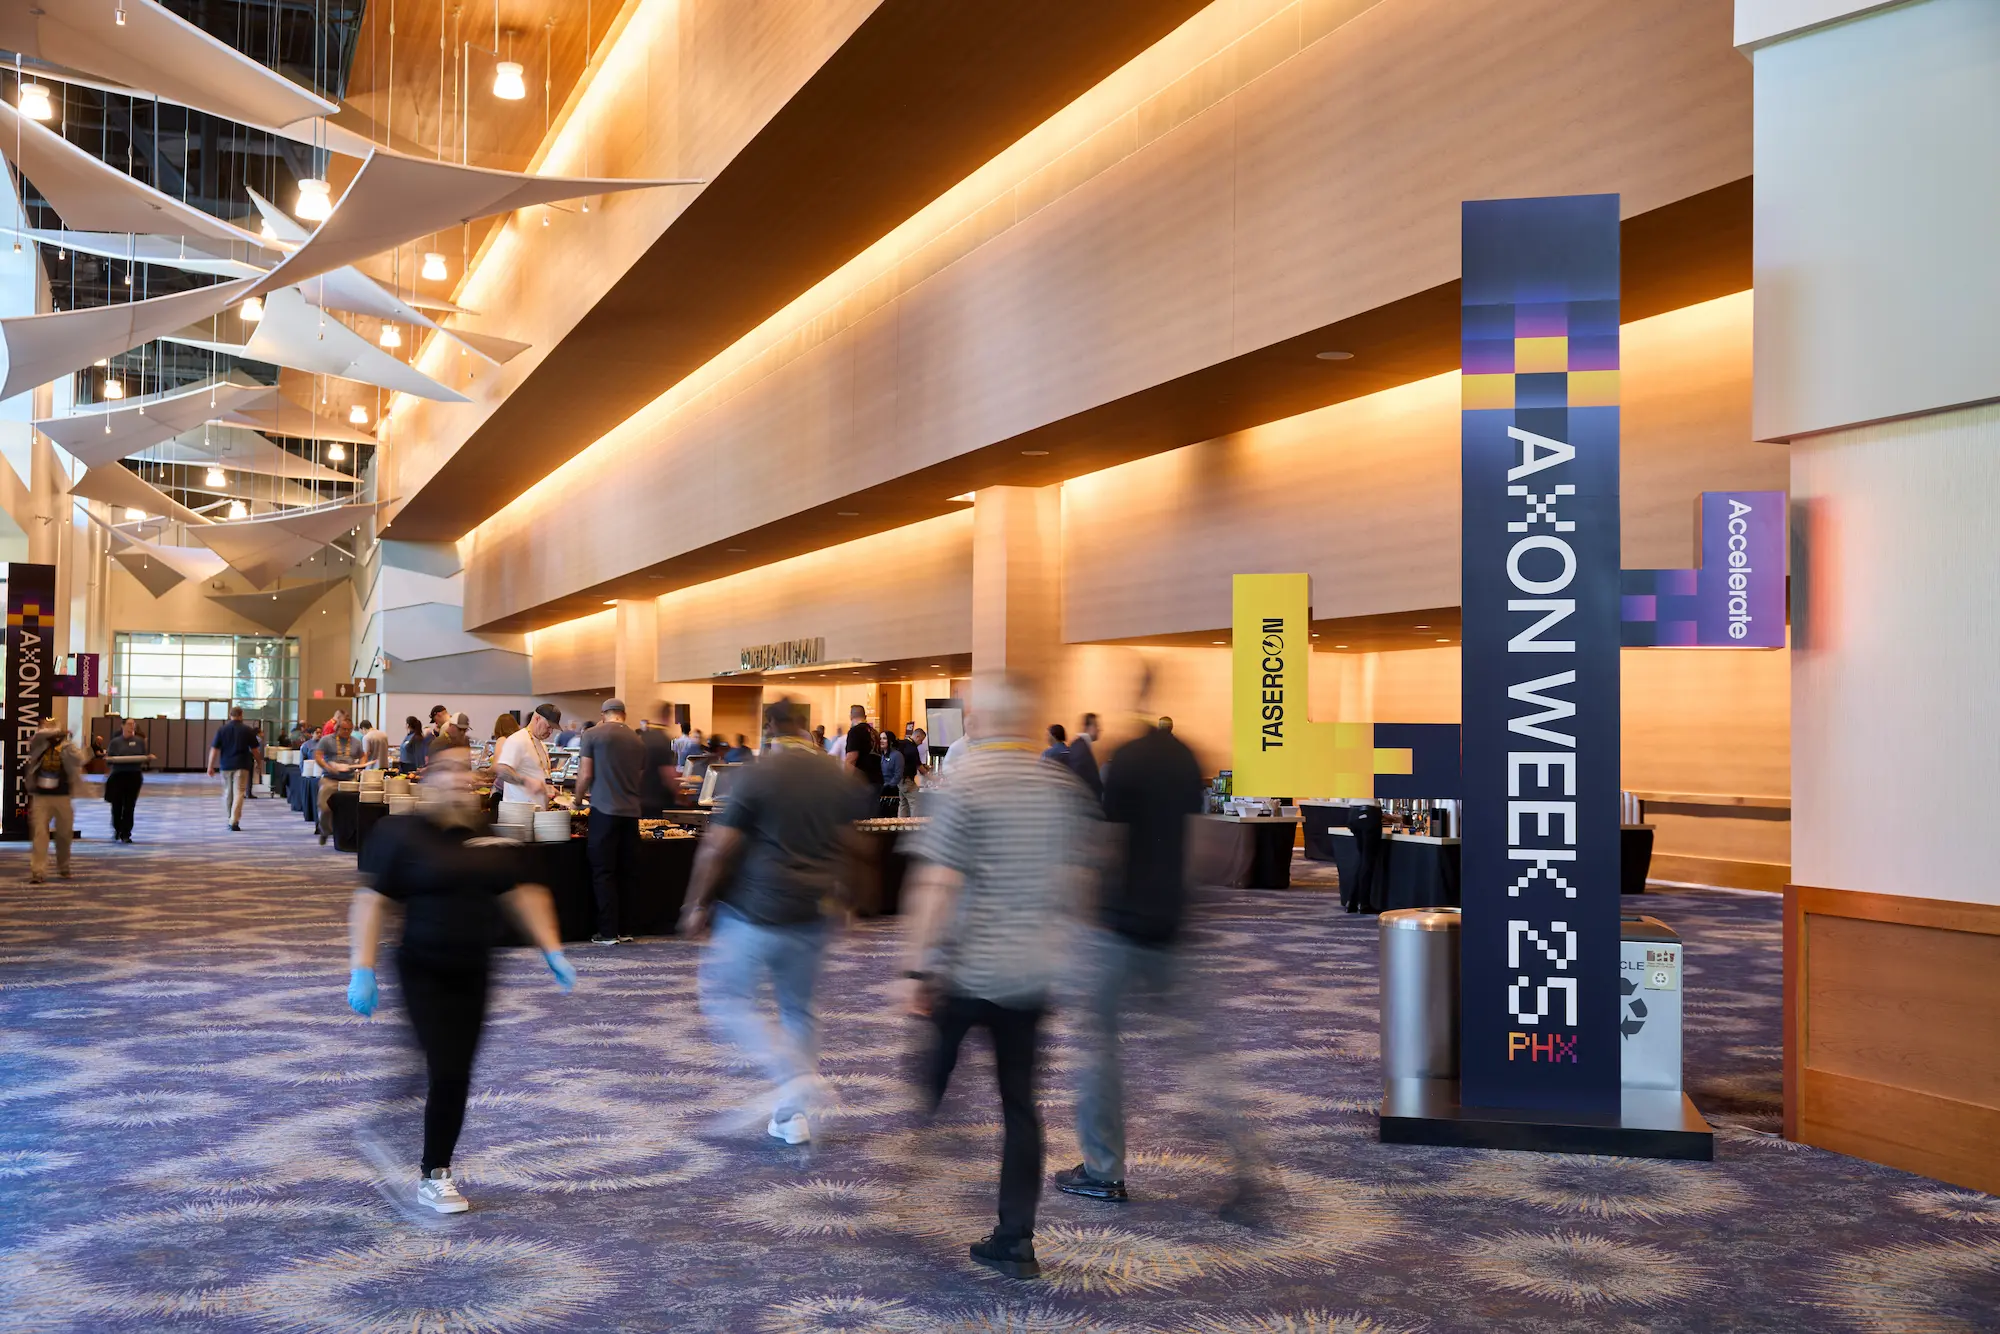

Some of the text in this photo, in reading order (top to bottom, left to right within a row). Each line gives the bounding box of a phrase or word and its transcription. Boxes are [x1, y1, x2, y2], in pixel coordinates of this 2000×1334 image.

[1727, 499, 1753, 640] Accelerate
[18, 629, 41, 699] AXON
[82, 655, 91, 695] Accelerate
[1262, 618, 1284, 752] TASERCON
[1506, 426, 1578, 1026] AXON WEEK 25
[1508, 1032, 1578, 1063] PHX
